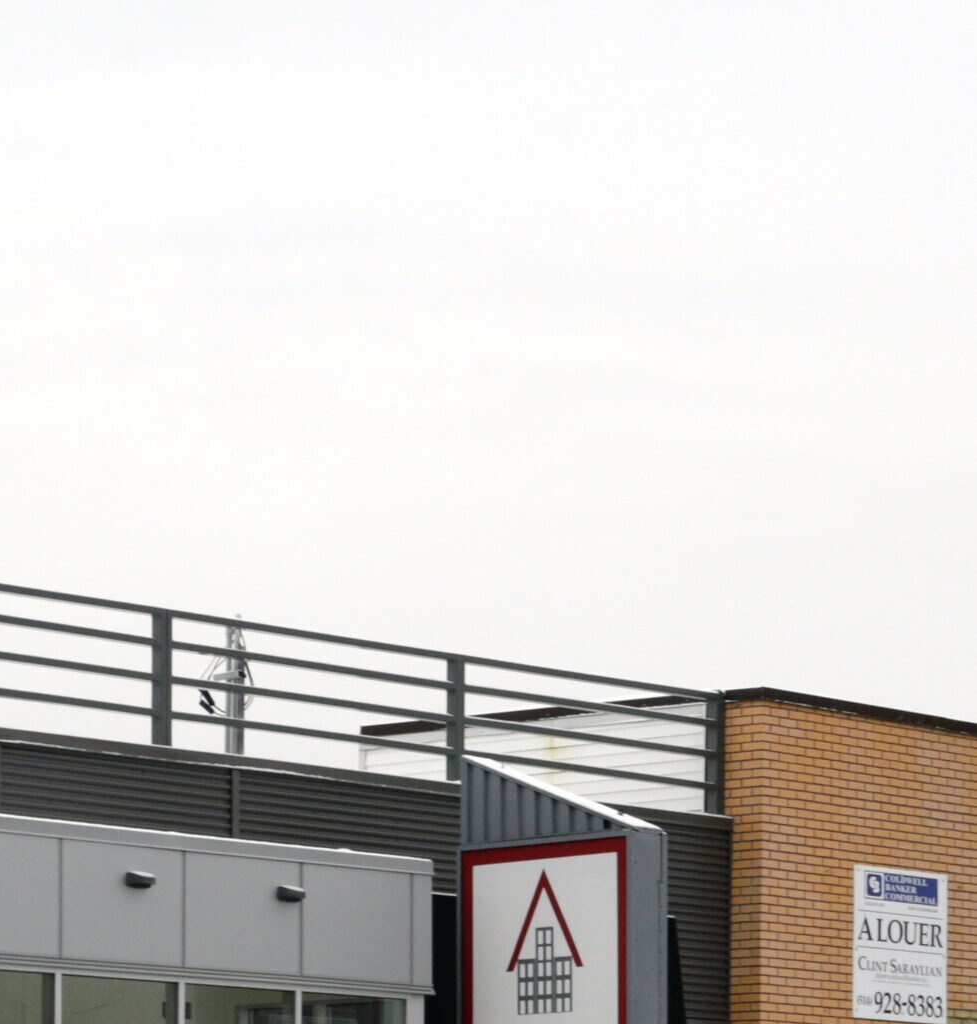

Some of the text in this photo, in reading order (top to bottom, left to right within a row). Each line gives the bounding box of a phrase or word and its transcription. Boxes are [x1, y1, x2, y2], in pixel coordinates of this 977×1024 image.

[885, 874, 928, 886] COLDWELL
[885, 883, 917, 894] BANKER
[885, 893, 938, 905] COMMERCIAL
[876, 918, 943, 948] LOUER
[874, 991, 943, 1018] 928-8383
